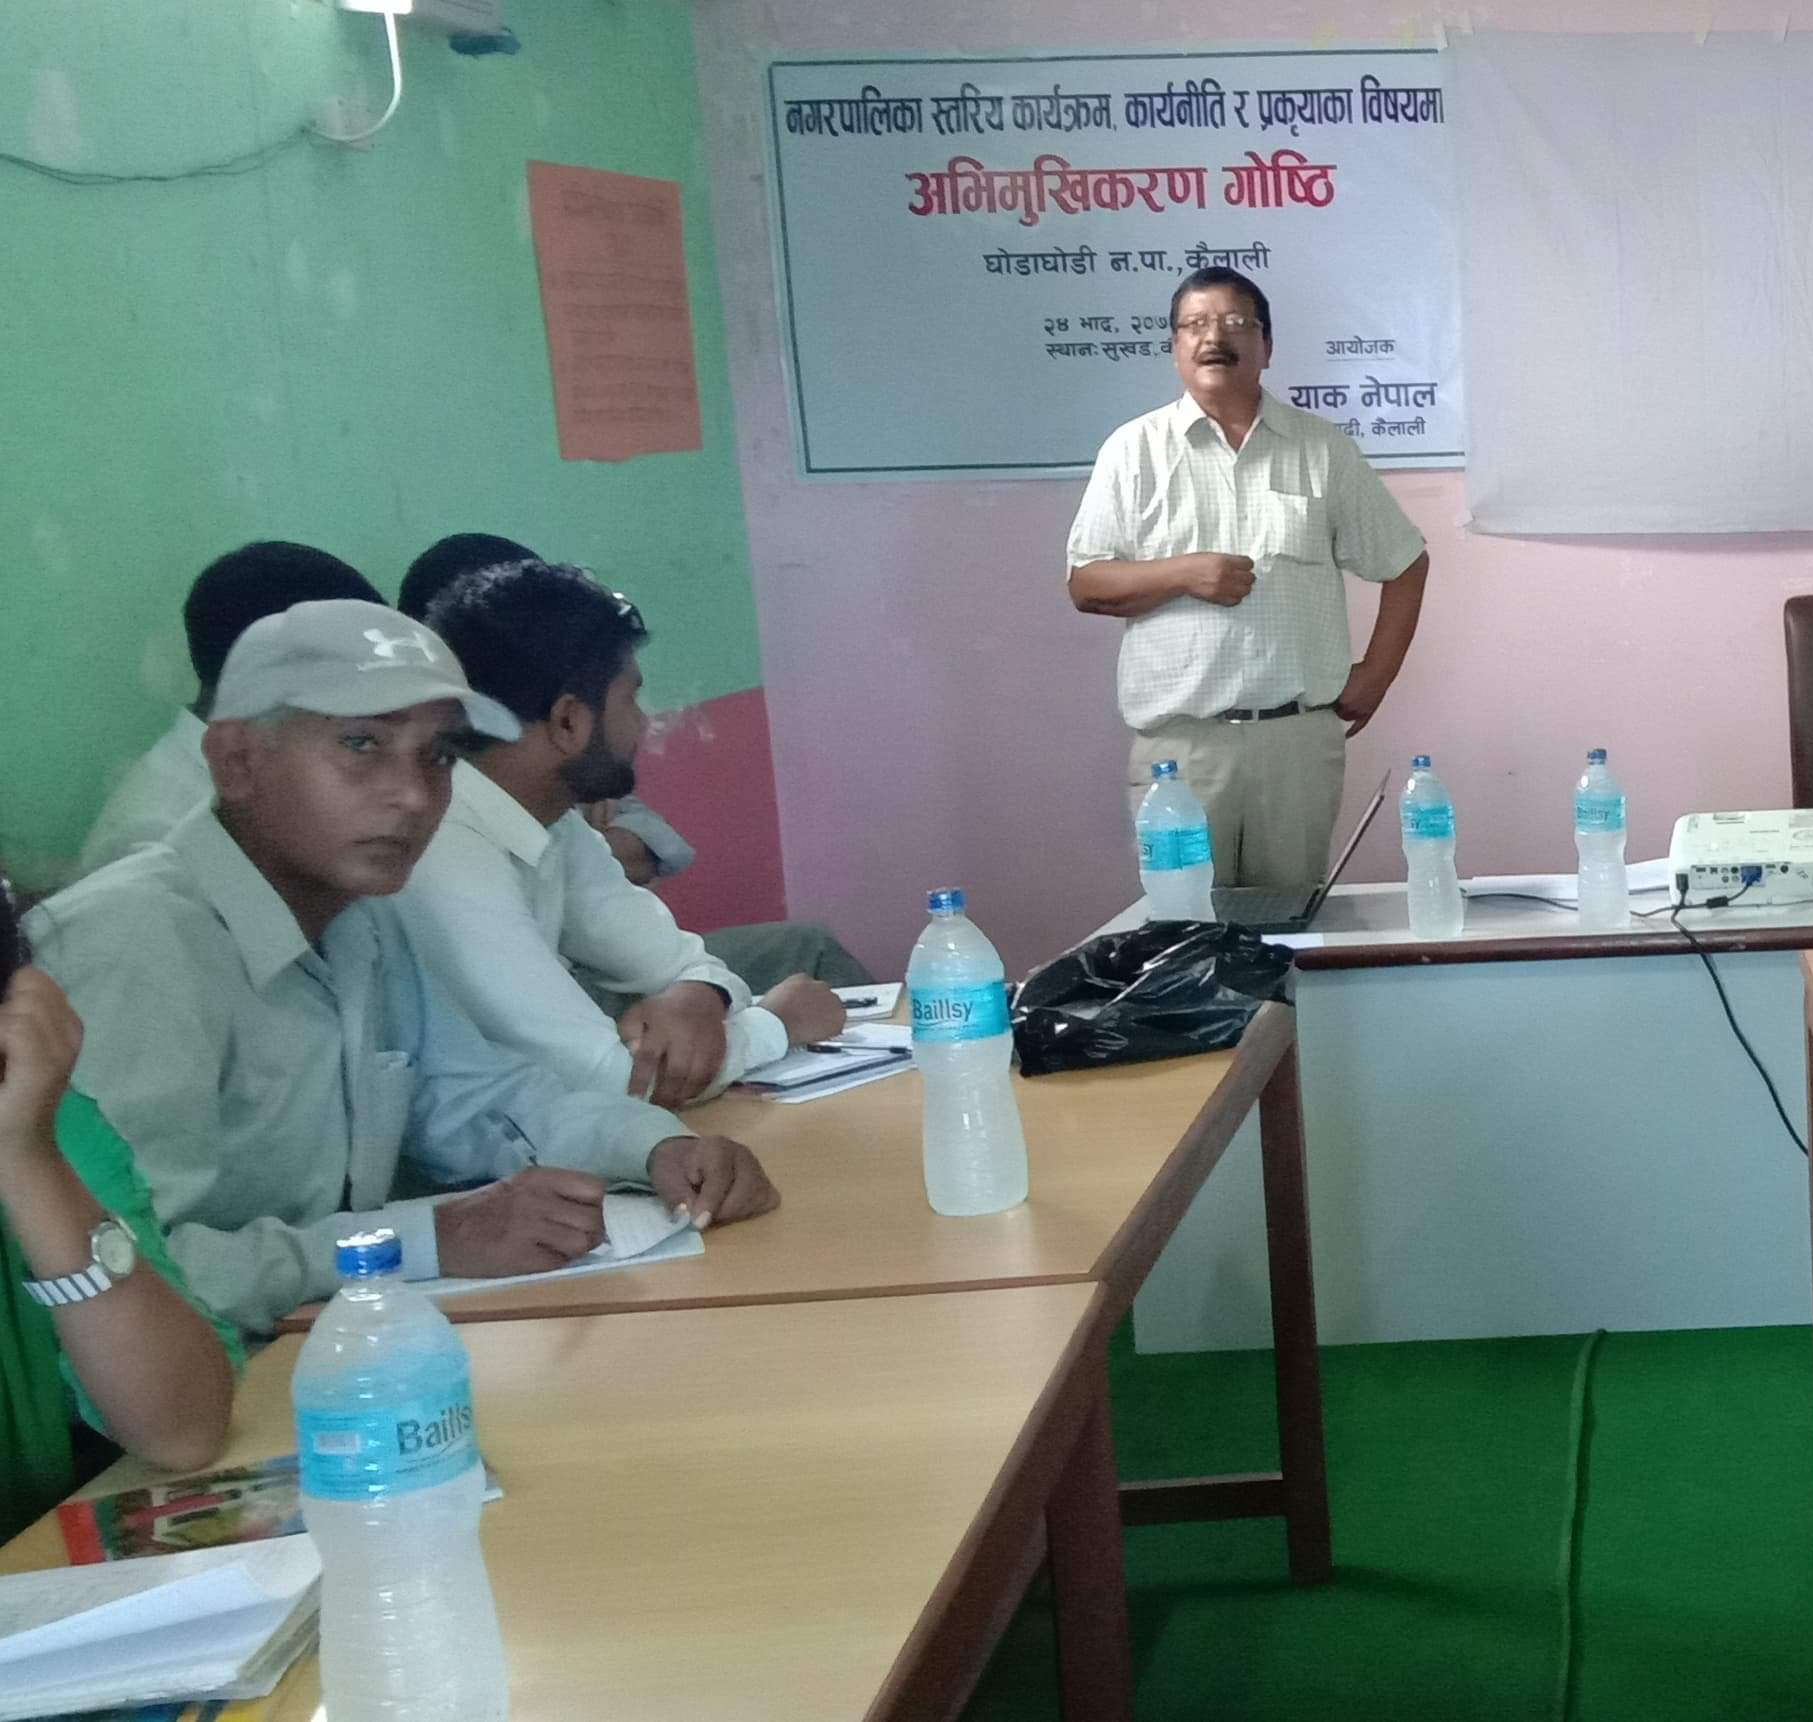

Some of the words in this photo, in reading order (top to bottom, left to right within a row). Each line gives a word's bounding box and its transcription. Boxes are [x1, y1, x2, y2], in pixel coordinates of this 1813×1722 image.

[784, 85, 922, 136] नगरपालिका
[931, 83, 1004, 135] स्तरिय
[1124, 78, 1226, 128] कार्यनीति
[1233, 90, 1250, 128] र
[1257, 88, 1353, 137] प्रकृयाका
[1361, 74, 1445, 124] विषयमा
[905, 154, 1208, 227] अभिमुखिकरण
[1222, 149, 1337, 208] गोष्ठि
[983, 245, 1098, 275] घोडाघोडी
[1044, 318, 1069, 336] २४
[1131, 316, 1170, 334] २०७
[1326, 335, 1396, 355] आयोजक
[1288, 384, 1350, 409] याक
[1359, 375, 1438, 408] नेपाल
[1371, 416, 1427, 437] कैलाली
[912, 999, 974, 1022] Baillsy
[396, 1402, 473, 1455] Baills
